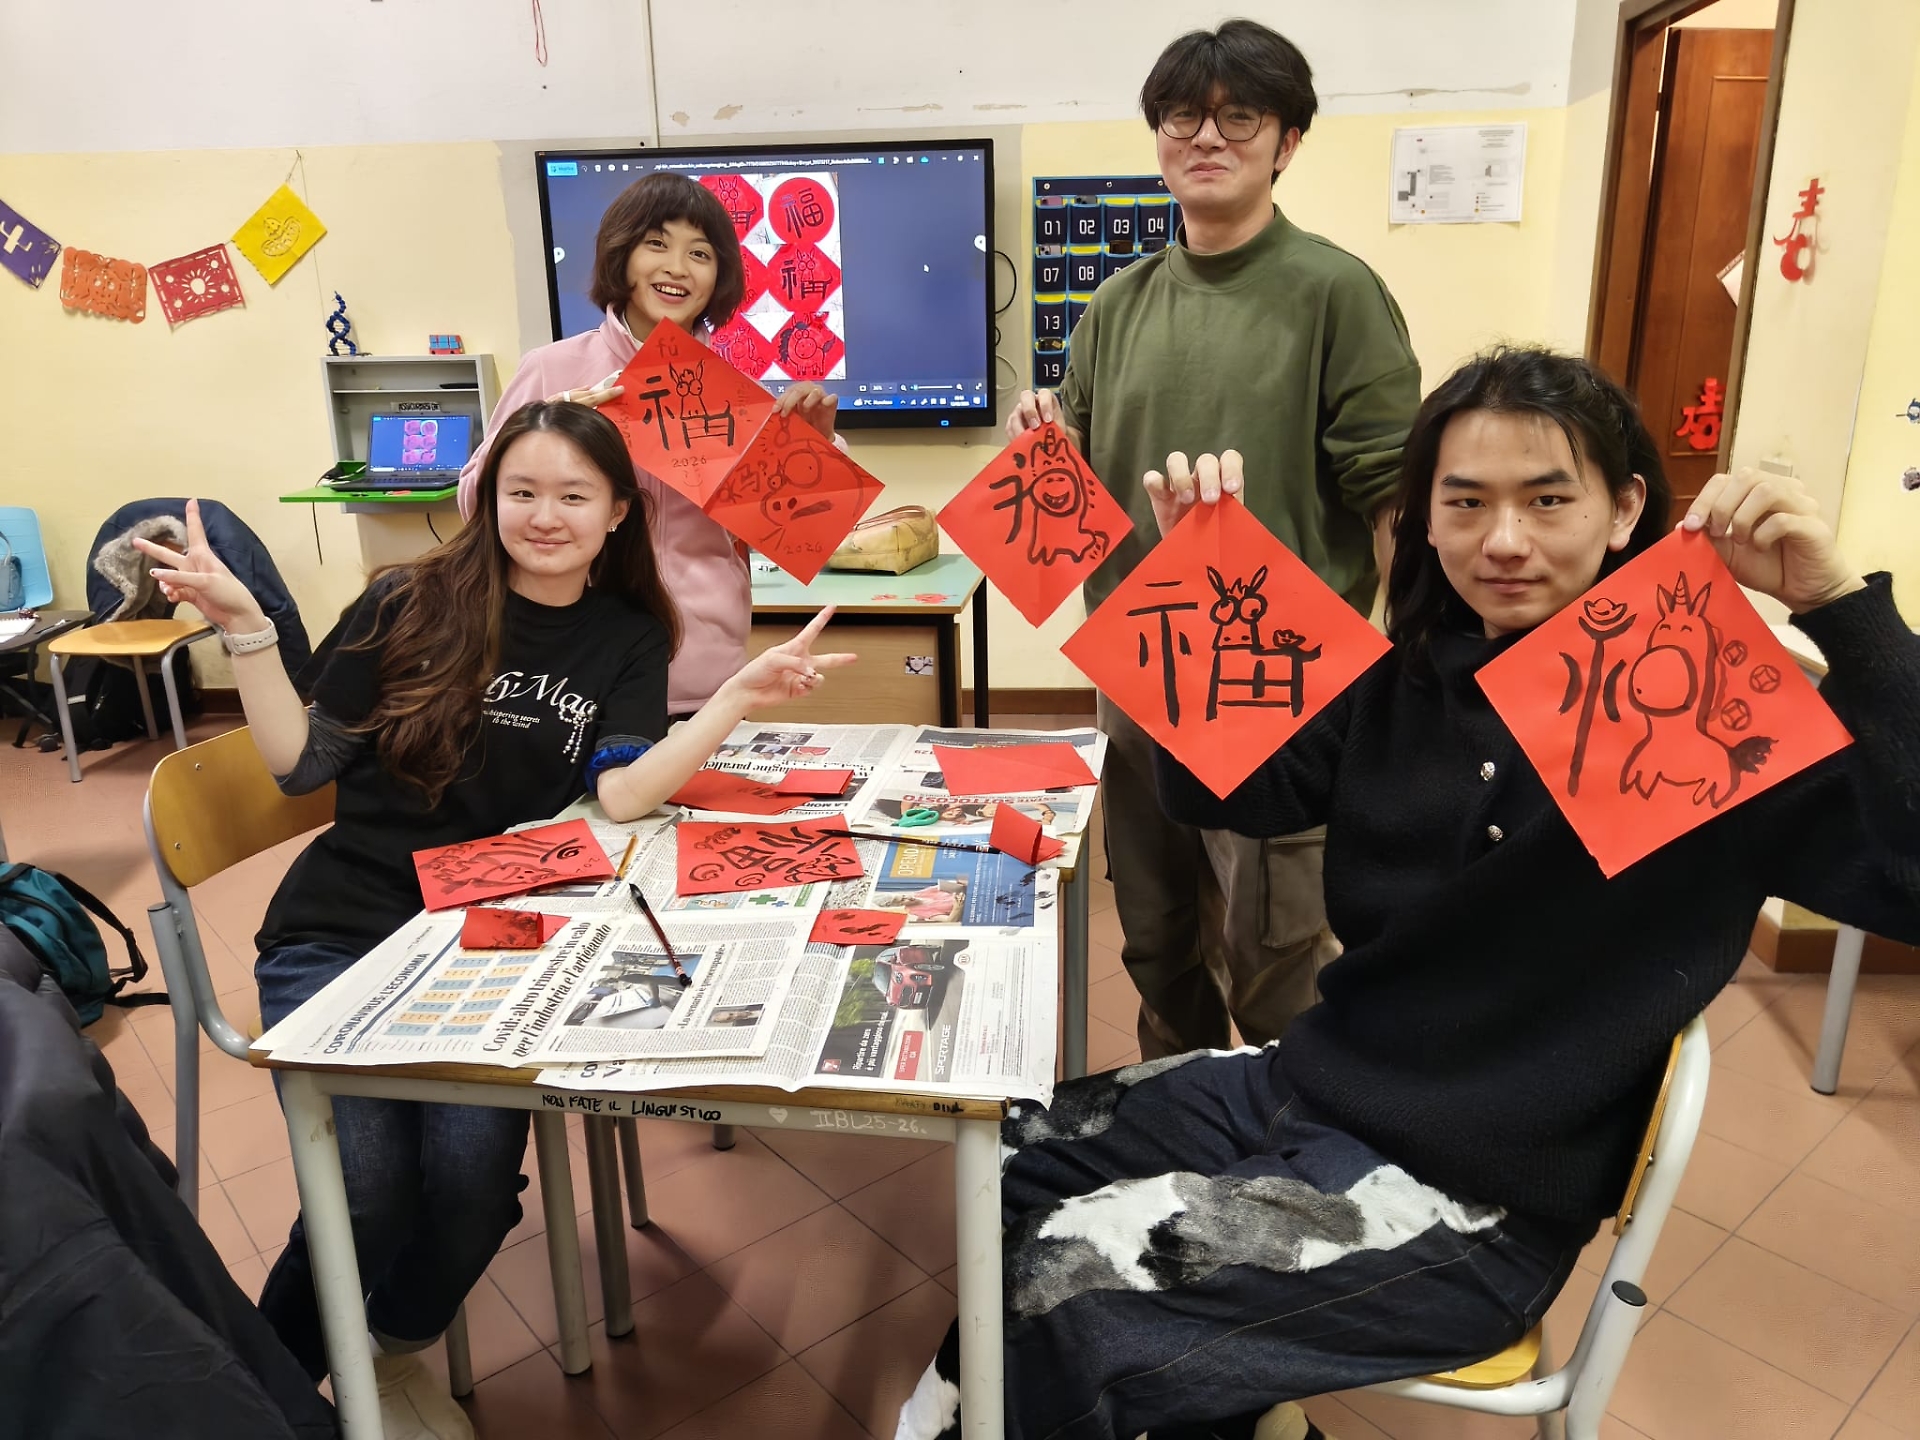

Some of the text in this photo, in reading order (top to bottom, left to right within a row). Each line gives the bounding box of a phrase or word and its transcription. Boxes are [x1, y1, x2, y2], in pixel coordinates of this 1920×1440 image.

[1044, 220, 1061, 235] 01
[1078, 219, 1096, 235] 02
[1113, 218, 1130, 234] 03
[1147, 217, 1165, 233] 04
[1043, 267, 1060, 283] 07
[1078, 265, 1095, 281] 08
[1043, 315, 1060, 330] 13
[1043, 363, 1060, 378] 19
[483, 1017, 521, 1051] Covid:
[510, 991, 540, 1017] altro
[528, 950, 570, 991] trimestre
[571, 922, 591, 942] calo
[323, 953, 430, 1054] CORONAVIRUS: L'ECONOMIA
[520, 984, 571, 1038] l'industria
[512, 1037, 533, 1057] per
[935, 1024, 951, 1075] SPORTAGE
[542, 1094, 565, 1108] NON
[569, 1095, 603, 1112] FATE
[608, 1101, 621, 1111] IL
